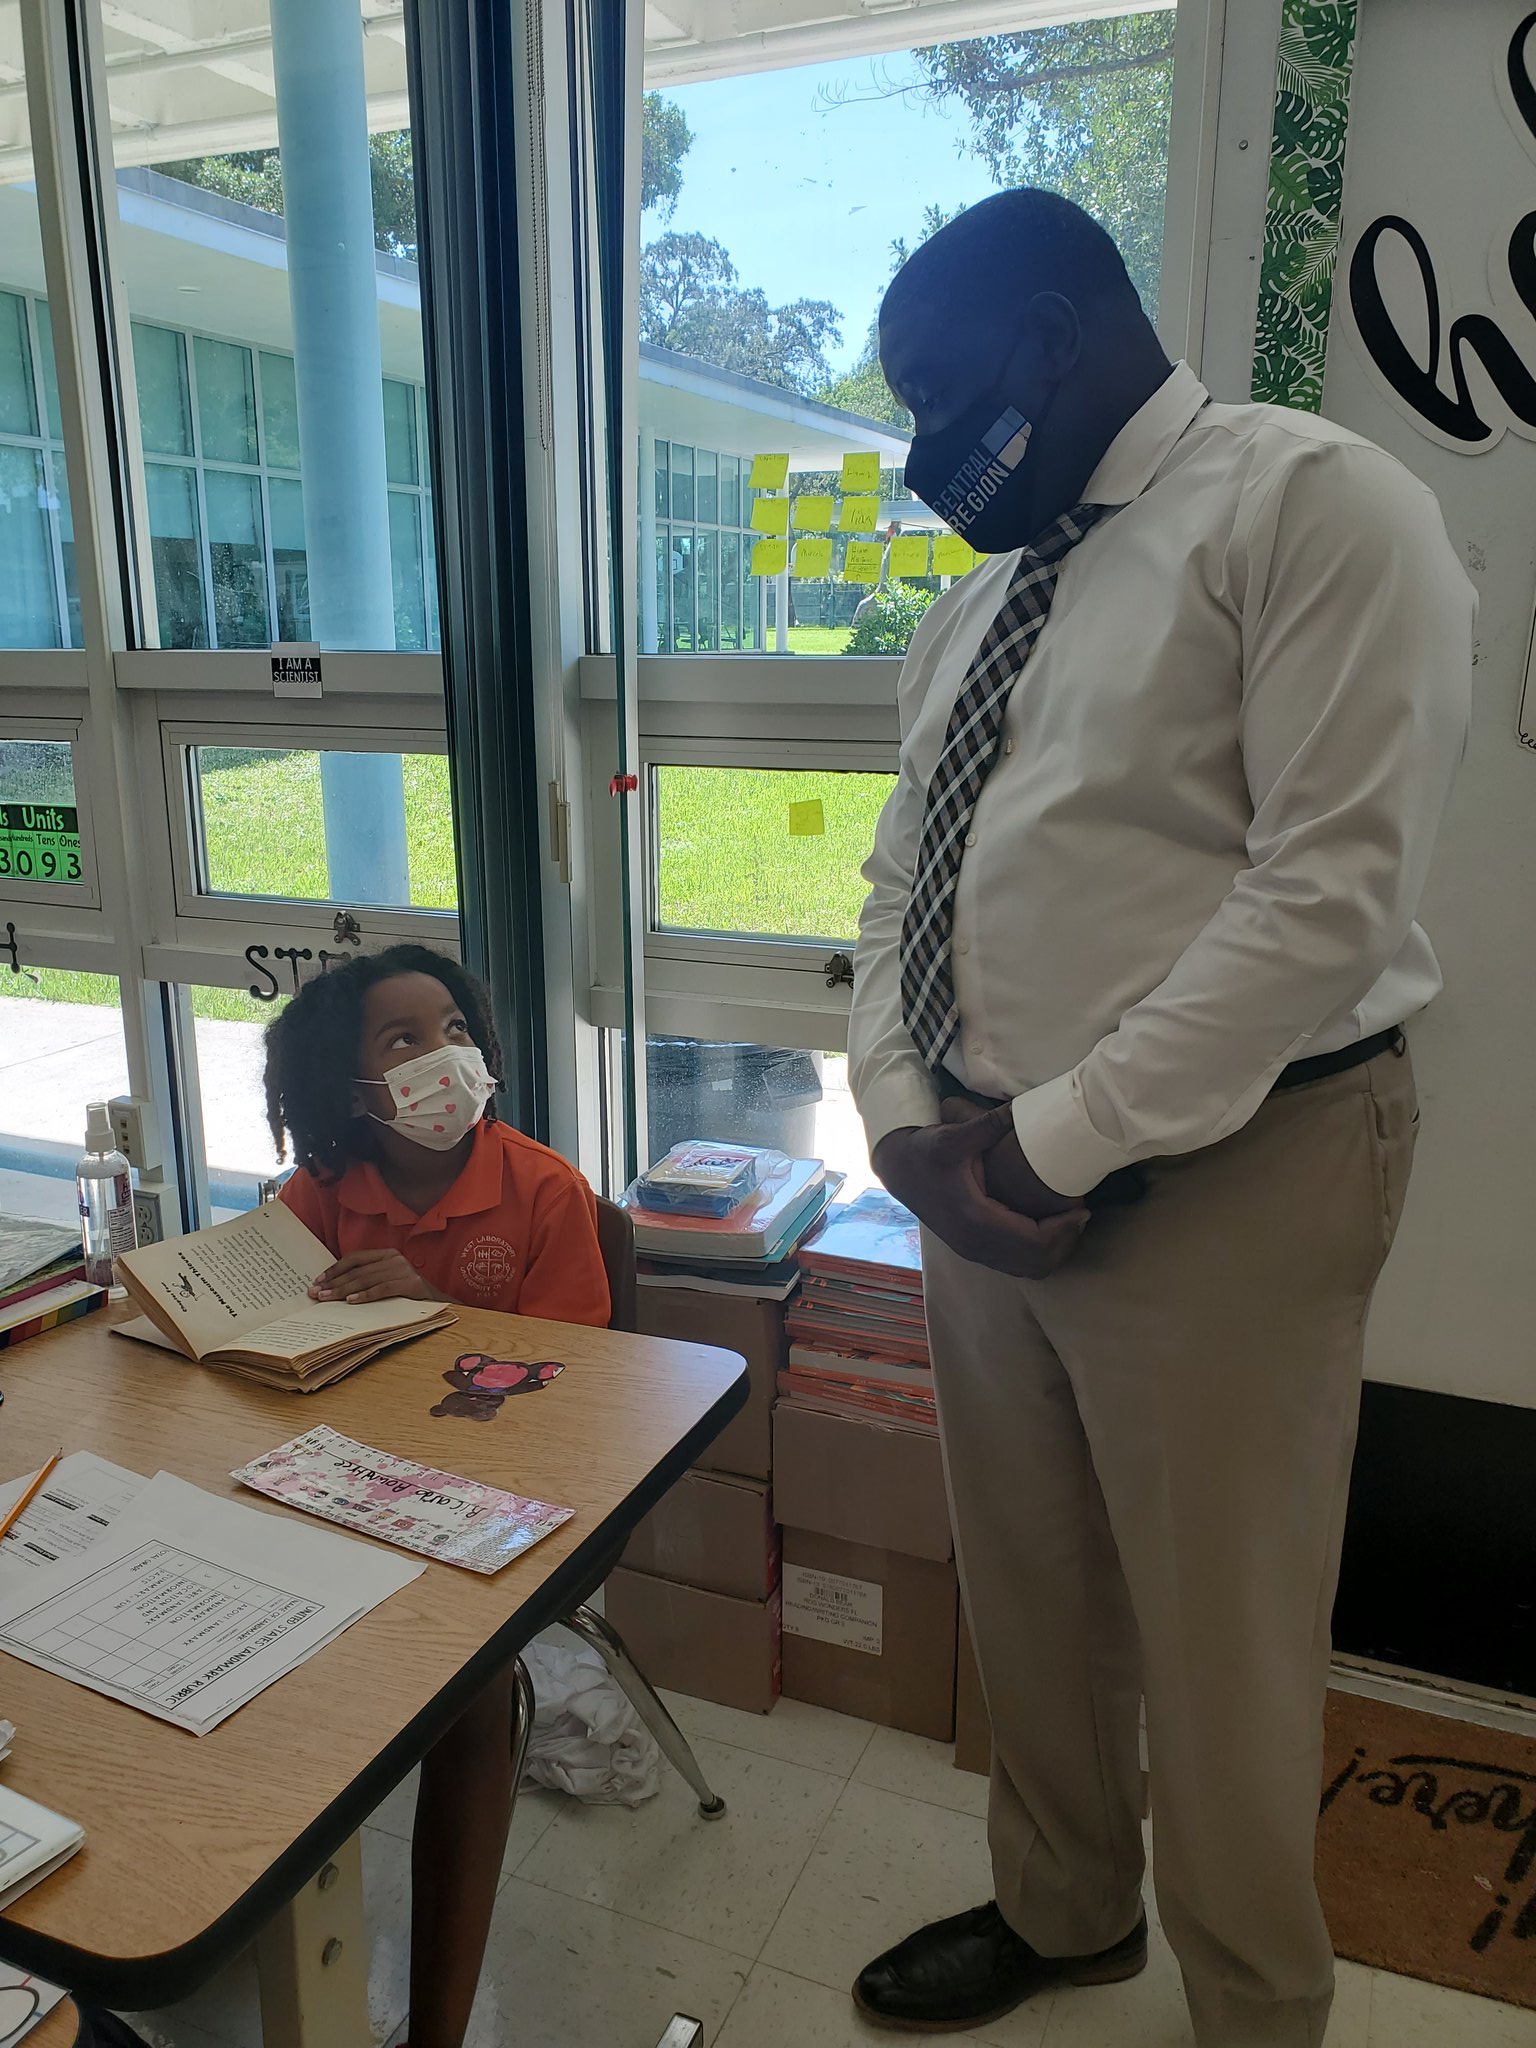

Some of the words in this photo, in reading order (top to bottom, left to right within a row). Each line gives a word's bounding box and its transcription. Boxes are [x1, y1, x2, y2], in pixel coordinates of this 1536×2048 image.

[931, 447, 993, 519] CENTRAL
[947, 461, 1010, 536] REGION
[279, 657, 284, 670] I
[286, 657, 302, 670] AM
[304, 657, 313, 670] A
[273, 671, 319, 683] SCIENTIST
[21, 806, 65, 831] Units
[36, 833, 56, 846] Tens
[59, 834, 81, 849] Ones
[177, 1252, 201, 1277] Thieves
[200, 1277, 226, 1304] Museum
[225, 1304, 237, 1317] The
[140, 1569, 165, 1584] FACTS
[136, 1578, 188, 1610] INFORMATION
[158, 1582, 196, 1606] LOCATION
[141, 1606, 158, 1616] AND
[145, 1599, 185, 1625] LANDMARK
[169, 1592, 220, 1624] INFORMATION
[191, 1596, 229, 1621] LANDMARK
[286, 1605, 315, 1624] UNITED
[183, 1619, 223, 1646] LANDMARK
[254, 1624, 287, 1646] STATES
[202, 1645, 255, 1680] LANDMARK
[165, 1679, 204, 1704] RUBRIC
